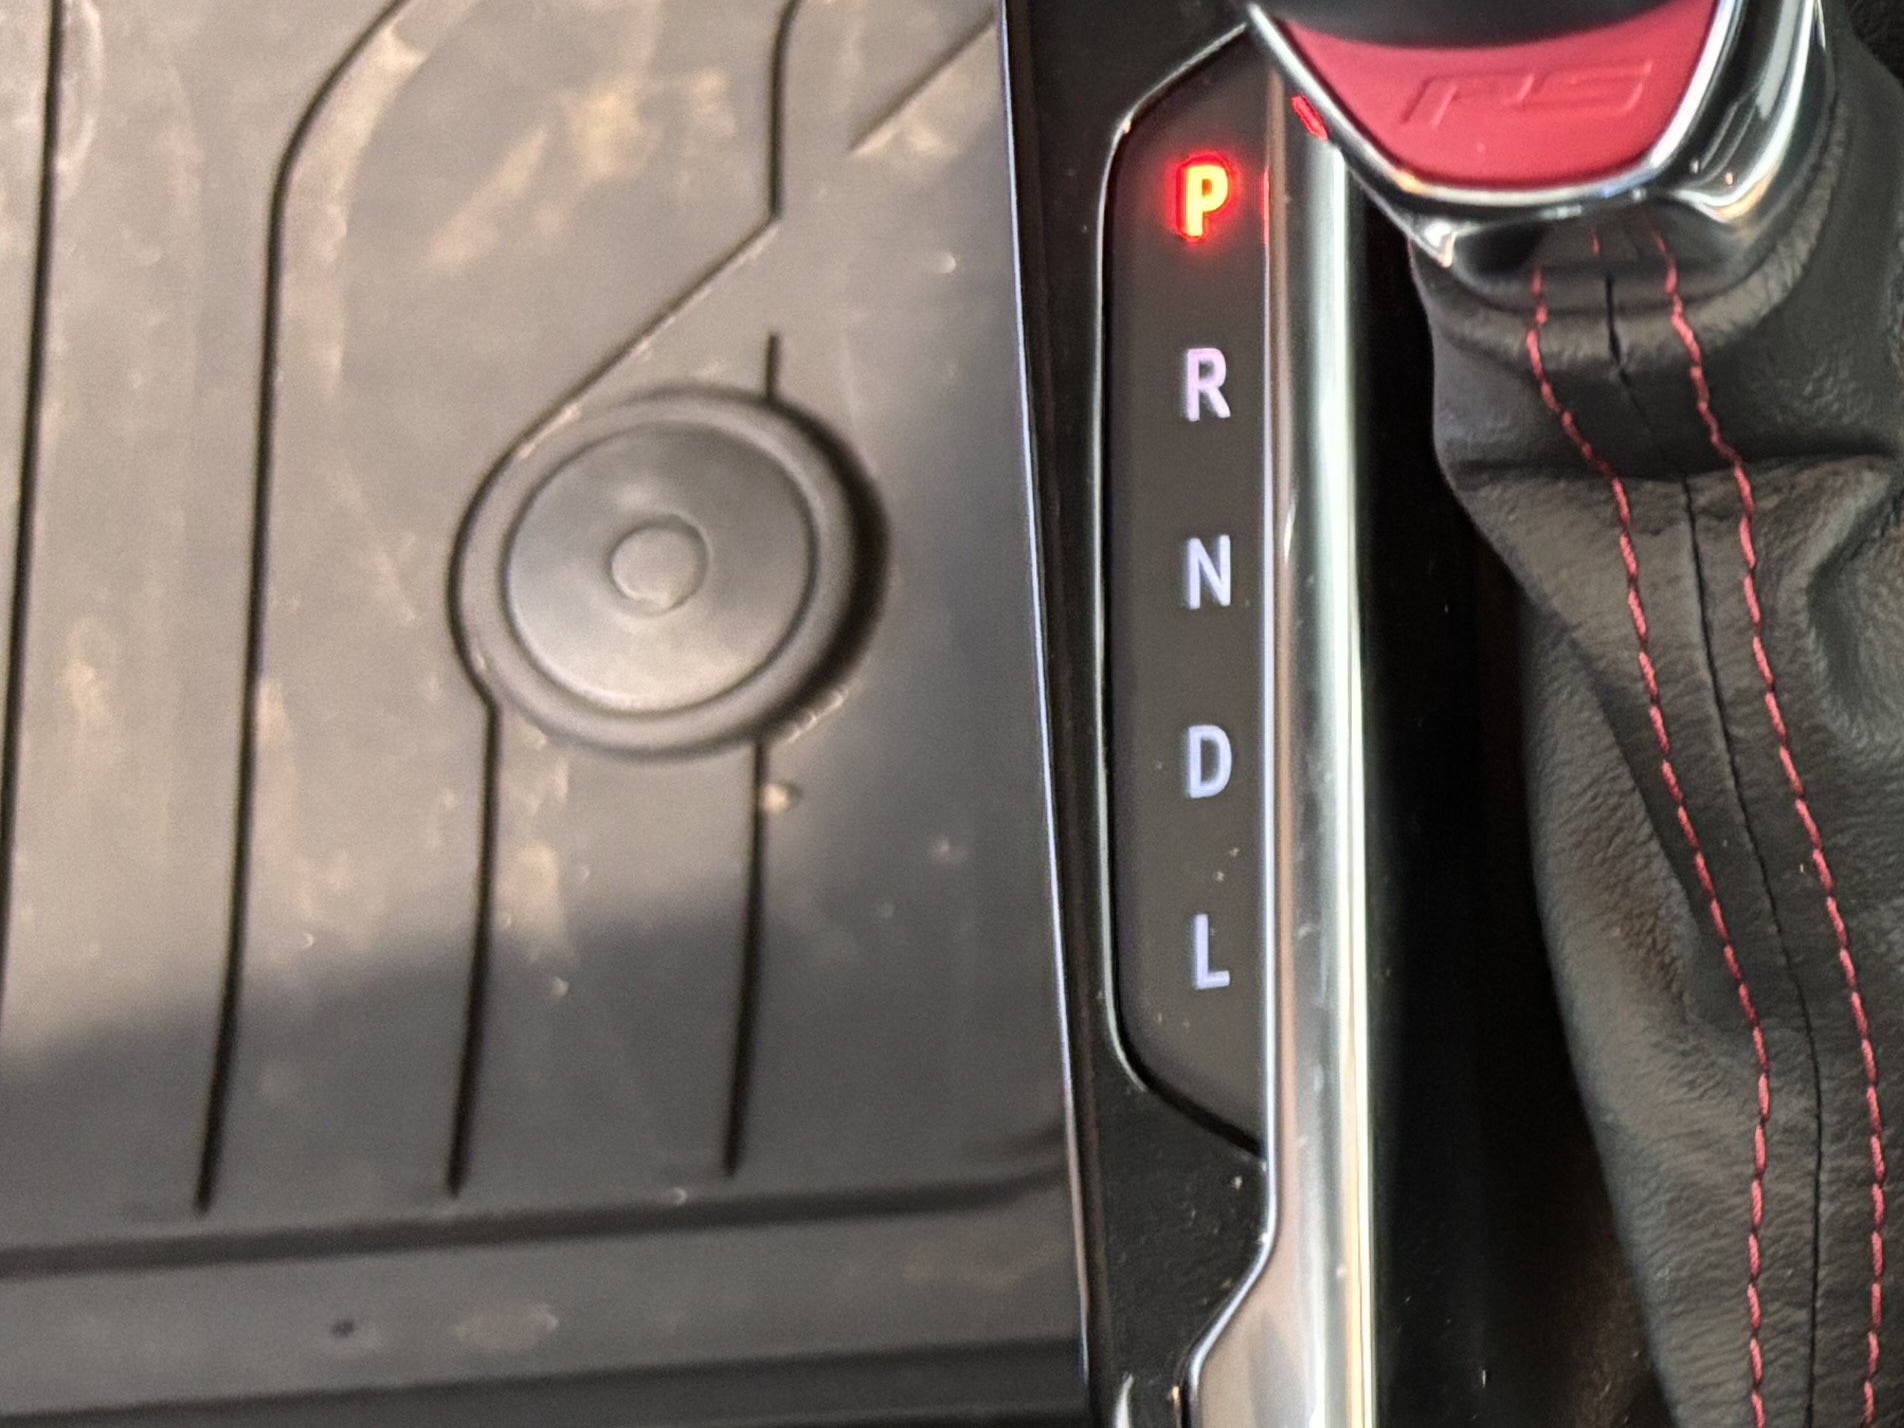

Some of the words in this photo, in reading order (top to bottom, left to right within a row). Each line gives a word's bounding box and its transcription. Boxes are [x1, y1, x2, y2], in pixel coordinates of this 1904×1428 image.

[1182, 162, 1230, 238] P
[1183, 346, 1232, 423] R
[1185, 533, 1233, 611] N
[1185, 723, 1234, 800] D
[1192, 912, 1232, 991] L
